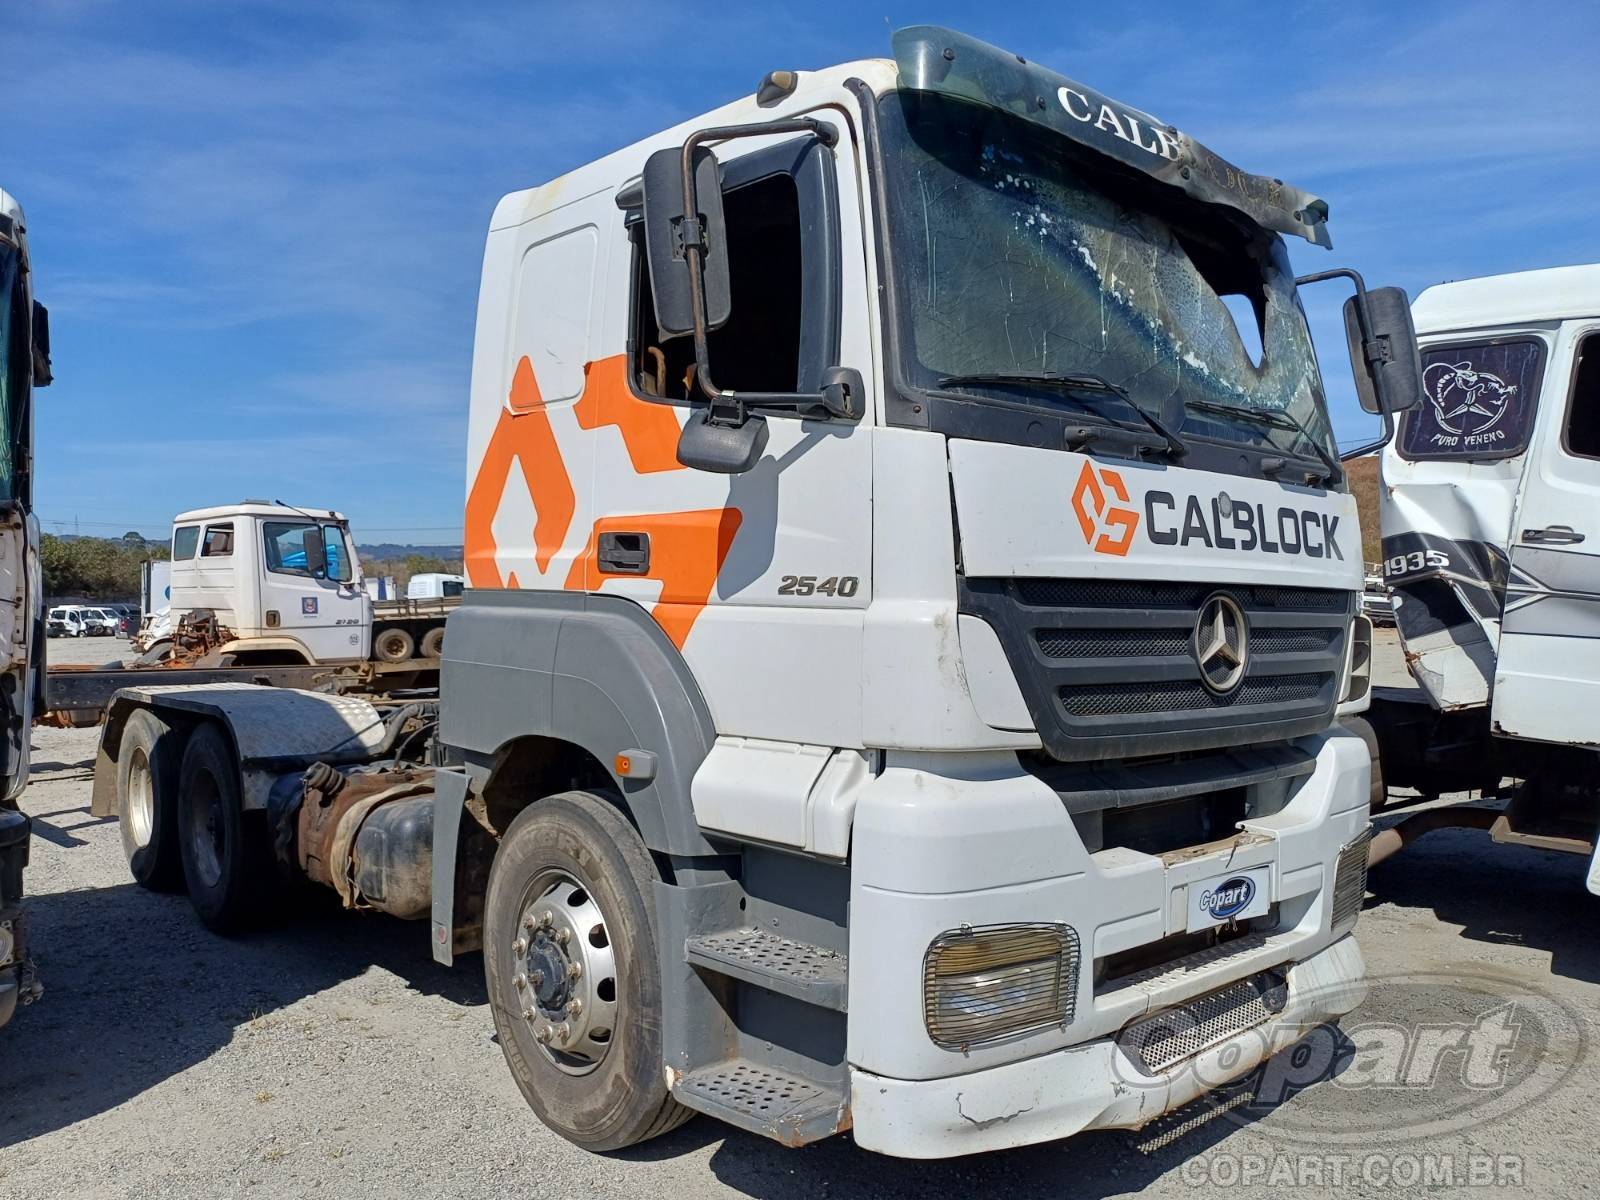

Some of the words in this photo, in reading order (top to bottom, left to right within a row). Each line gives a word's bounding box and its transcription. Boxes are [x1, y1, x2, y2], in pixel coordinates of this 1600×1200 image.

[1430, 433, 1459, 446] PURO
[1463, 430, 1505, 446] VENENO
[1144, 490, 1344, 561] CALBLOCK
[1383, 549, 1450, 577] 1935
[778, 575, 859, 598] 2540
[1200, 880, 1249, 912] Copart
